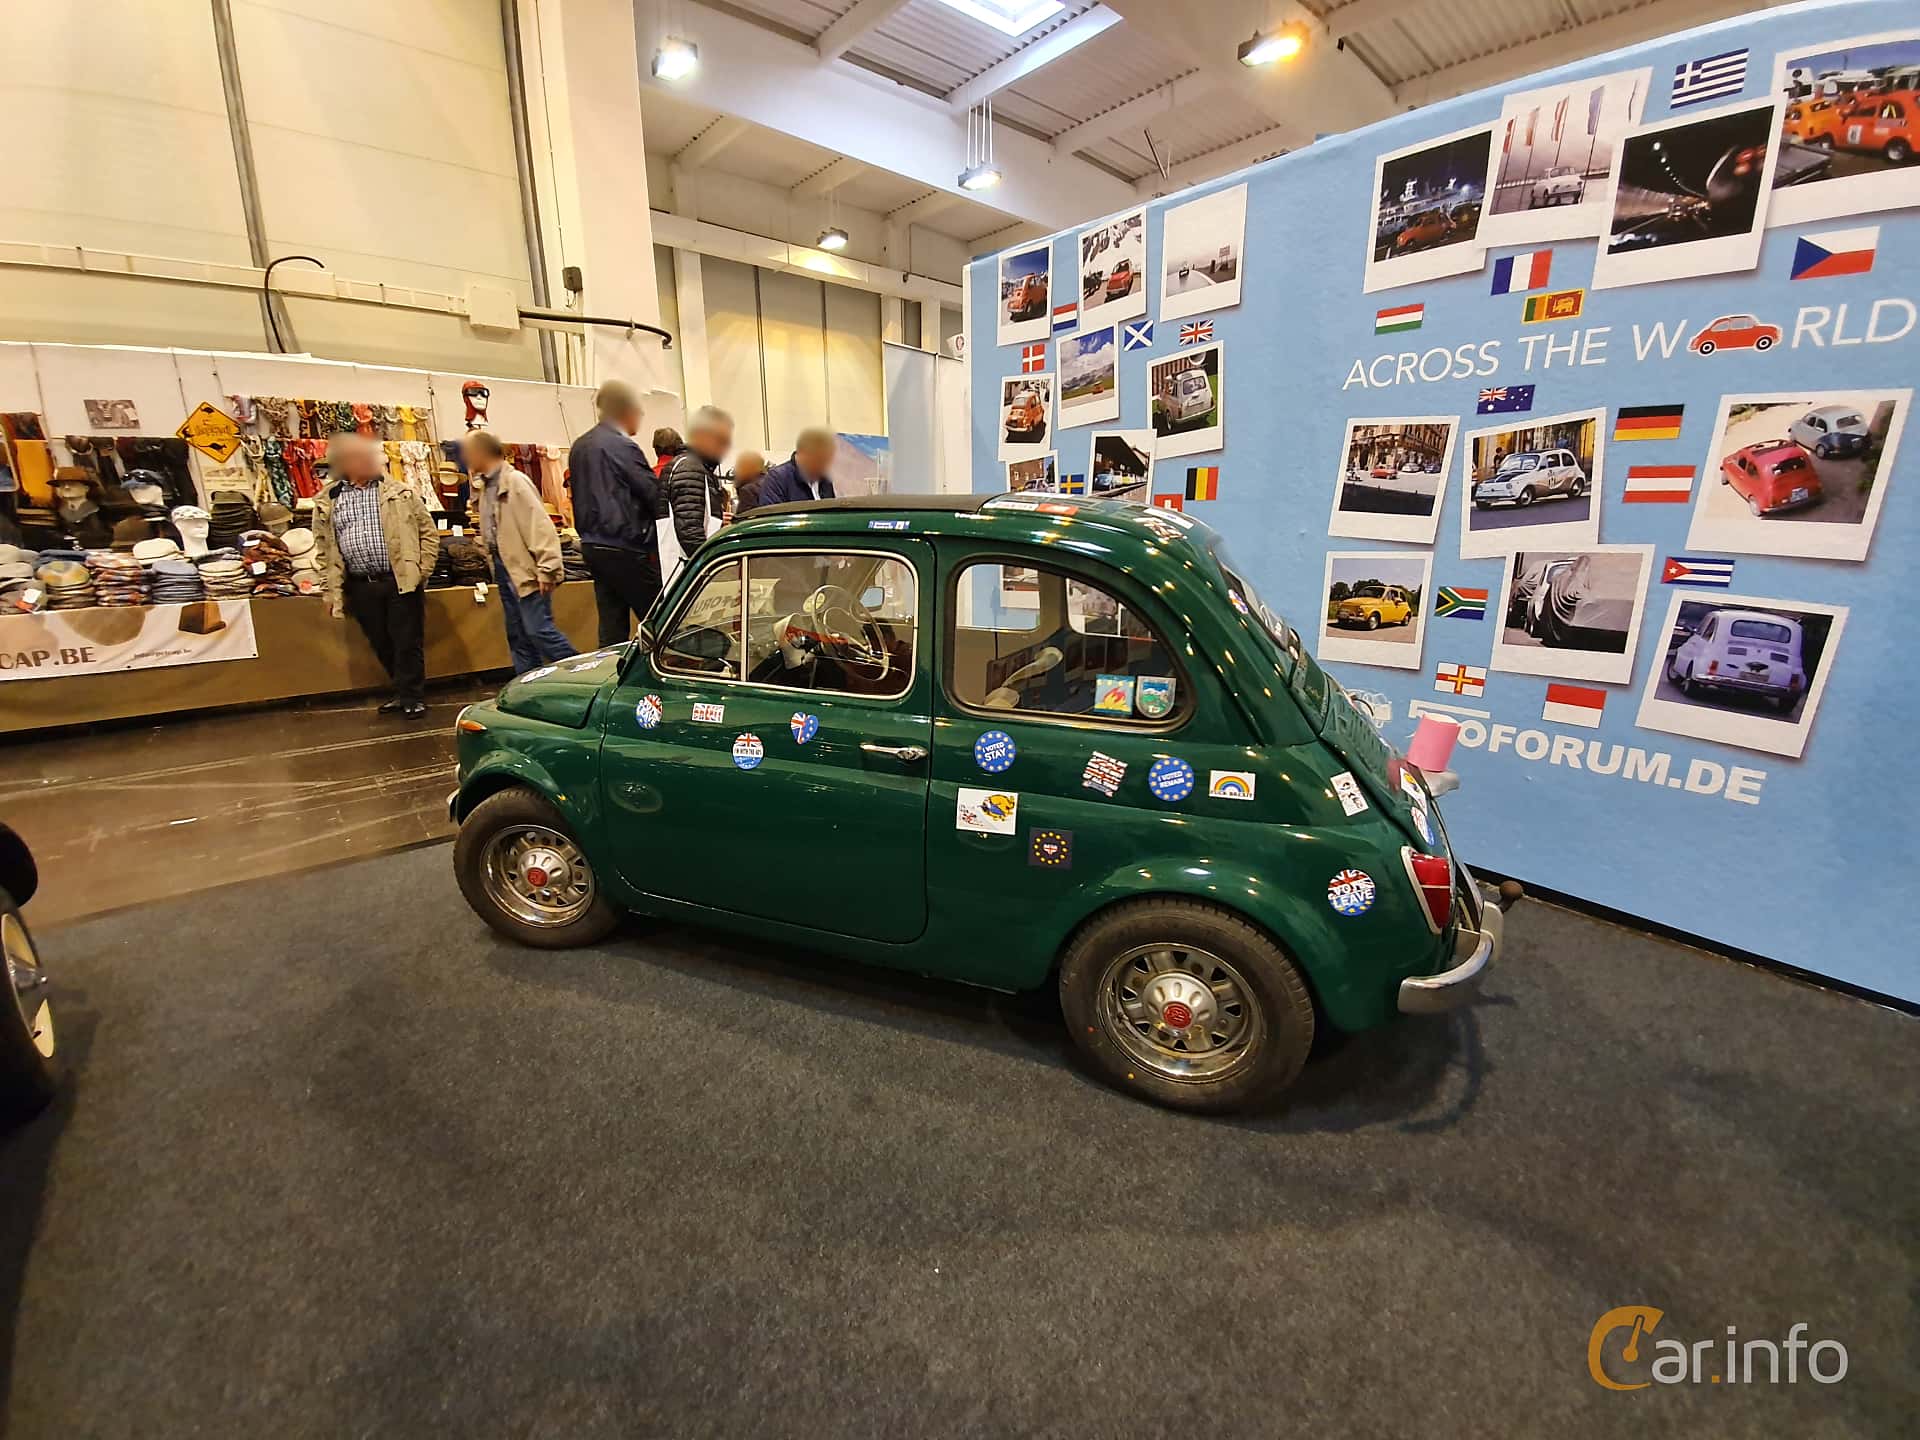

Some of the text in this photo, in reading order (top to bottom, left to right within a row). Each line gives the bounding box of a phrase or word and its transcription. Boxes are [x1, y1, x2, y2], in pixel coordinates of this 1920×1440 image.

[1342, 340, 1502, 390] ACROSS
[1518, 326, 1612, 371] THE
[985, 742, 1004, 752] VOTED
[985, 748, 1005, 761] STAY
[1334, 889, 1374, 909] LEAVE
